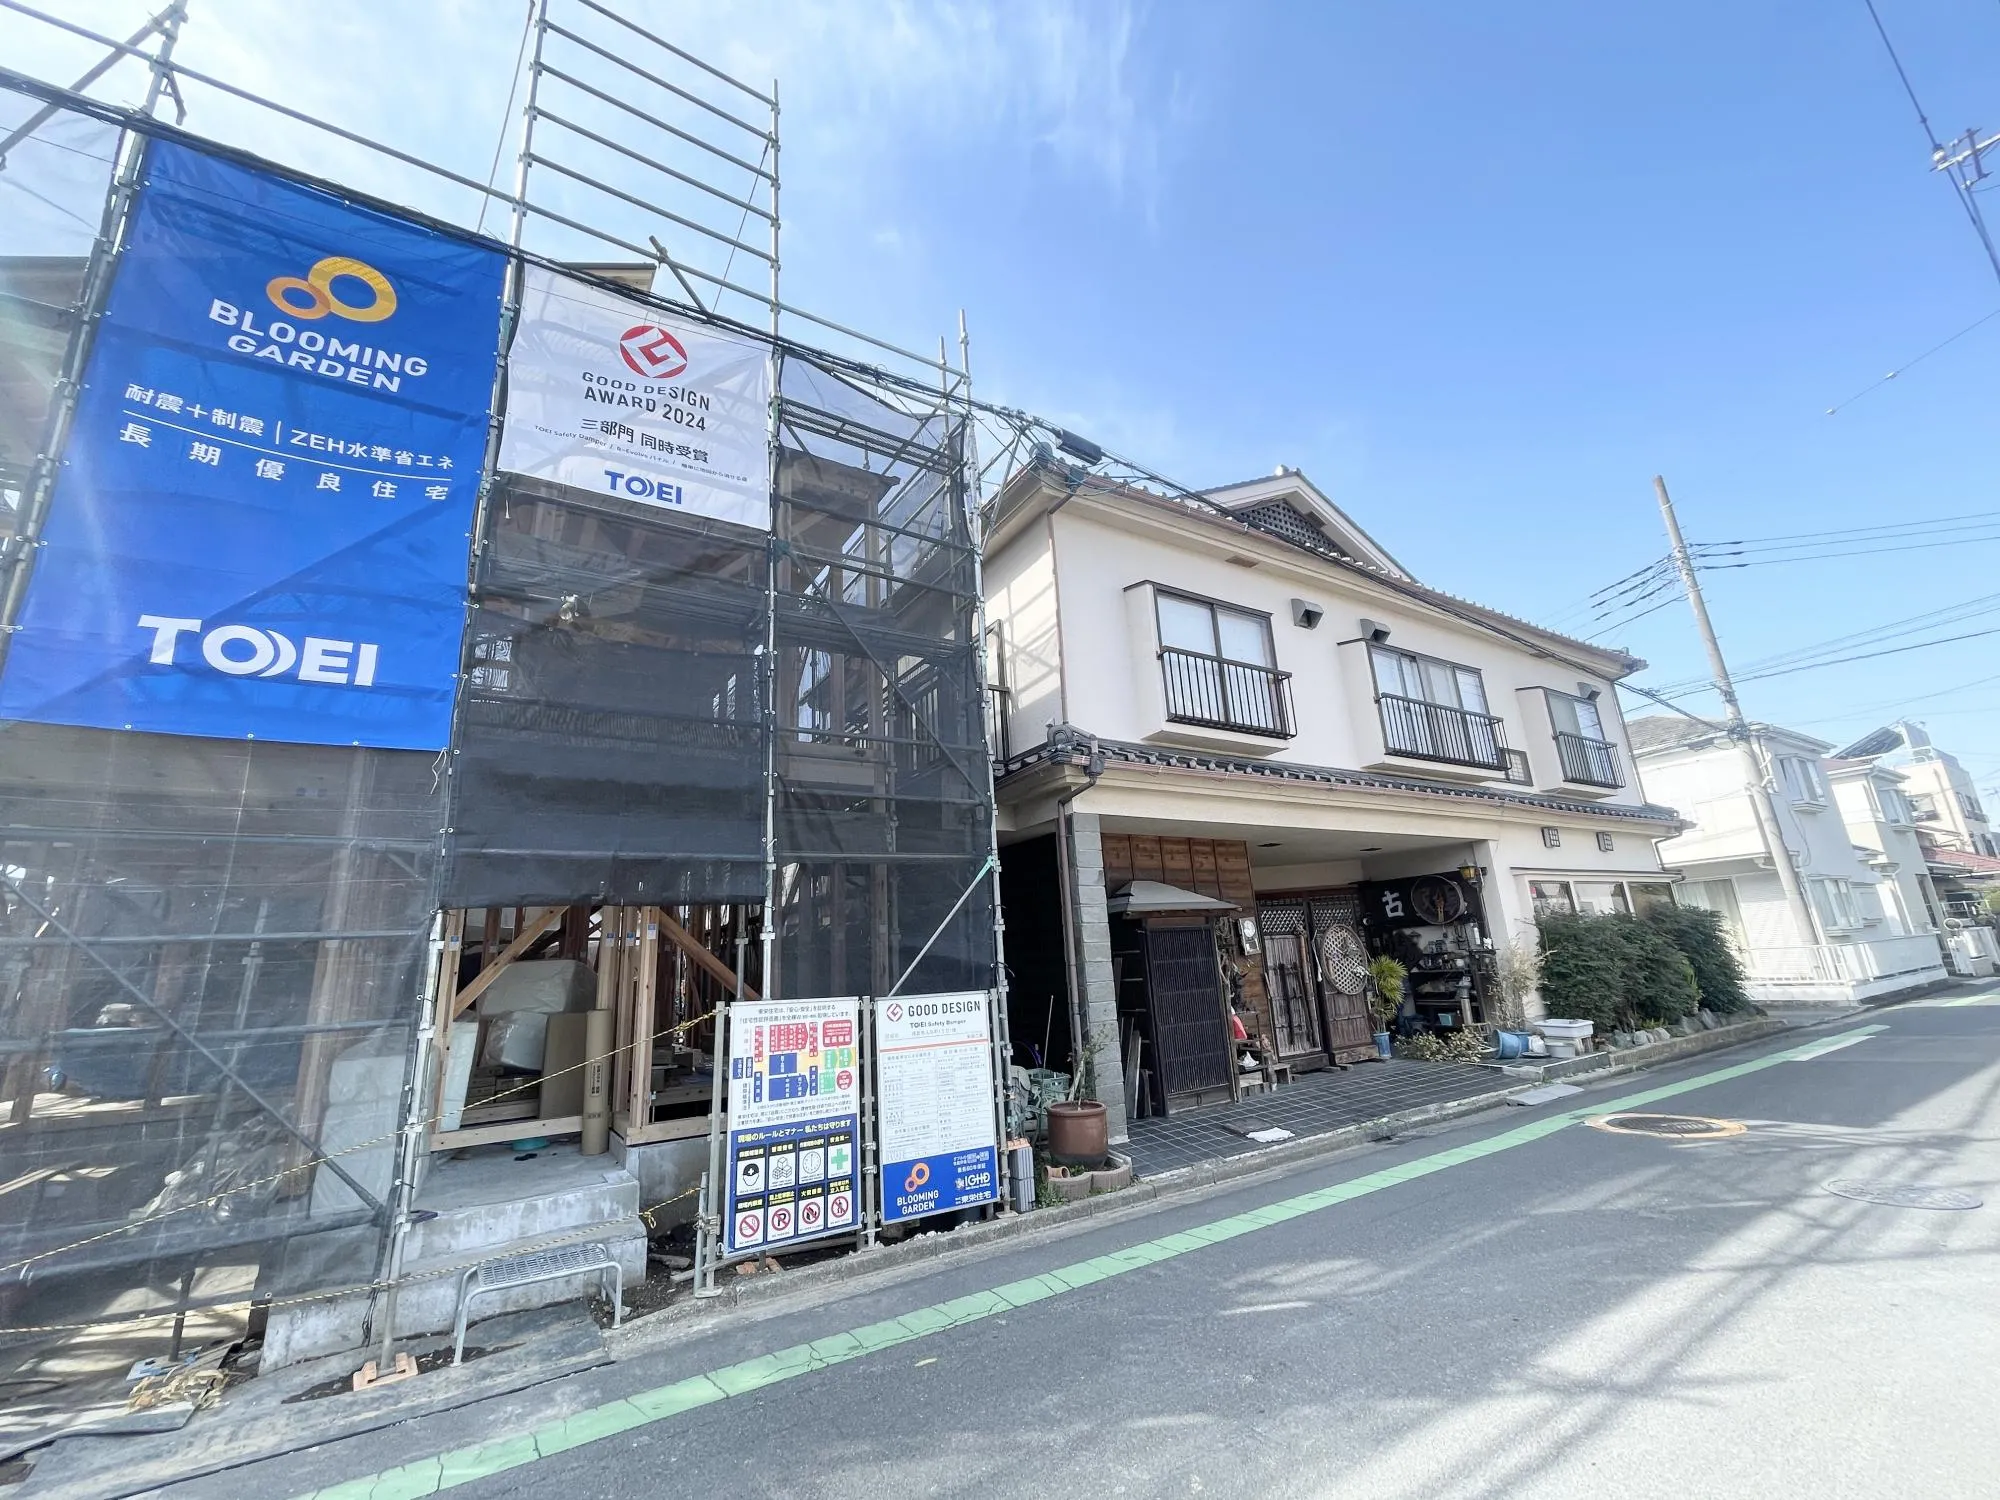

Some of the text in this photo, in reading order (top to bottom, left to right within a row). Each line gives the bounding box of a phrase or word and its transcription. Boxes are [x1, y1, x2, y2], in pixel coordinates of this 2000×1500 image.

[208, 298, 429, 377] BLOOMING
[227, 334, 401, 393] GARDEN
[582, 371, 710, 412] GOOD DESIGN
[584, 386, 706, 431] AWARD 2024
[290, 429, 454, 470] ZEH水準省エネ
[581, 418, 709, 464] 三部門 同時受賞
[604, 470, 682, 504] TOEI
[137, 614, 378, 687] TOEI
[908, 1000, 981, 1017] GOOD DESIGN
[896, 1190, 939, 1207] BLOOMING
[902, 1201, 935, 1215] GARDEN
